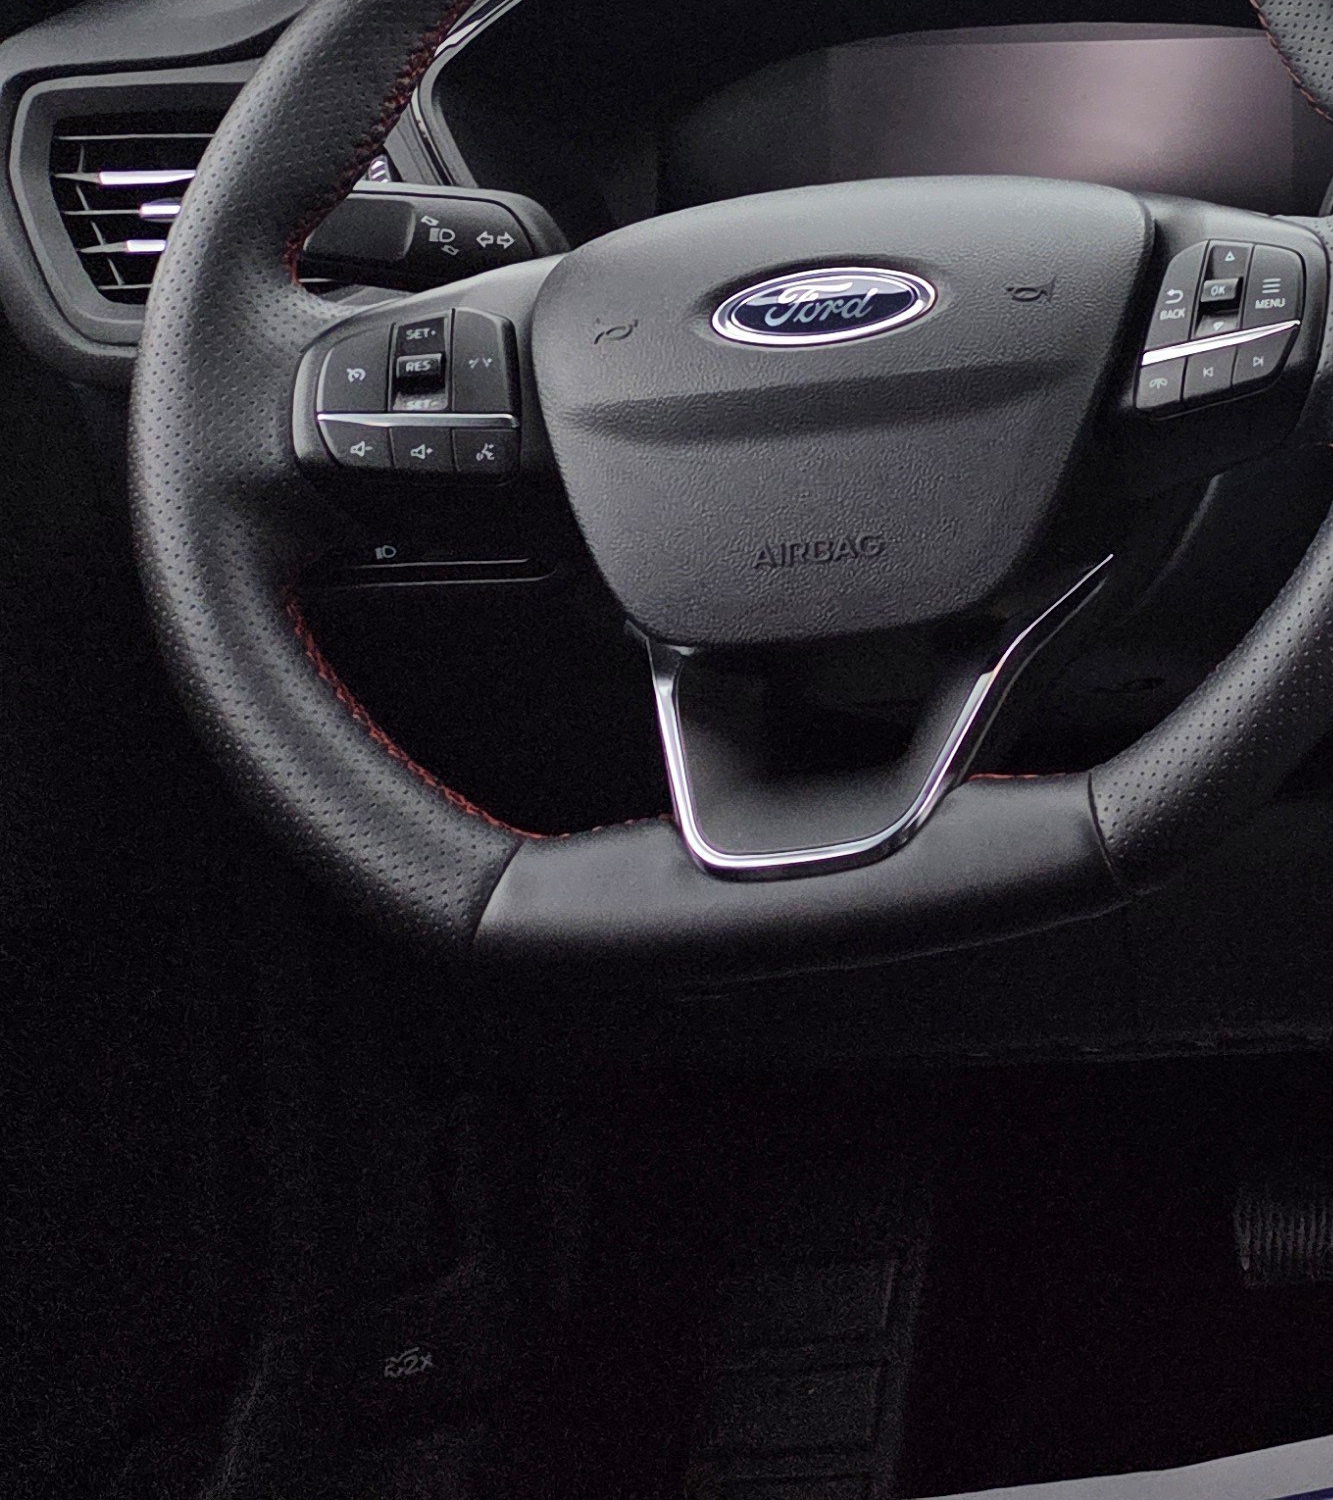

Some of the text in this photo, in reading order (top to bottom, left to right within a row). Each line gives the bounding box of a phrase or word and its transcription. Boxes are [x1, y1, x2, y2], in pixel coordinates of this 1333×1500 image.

[1210, 285, 1227, 297] OK
[764, 281, 879, 327] Ford
[1254, 297, 1286, 310] MENU
[1159, 307, 1186, 320] BACK
[405, 360, 432, 373] RES
[752, 530, 888, 569] AIRBAG
